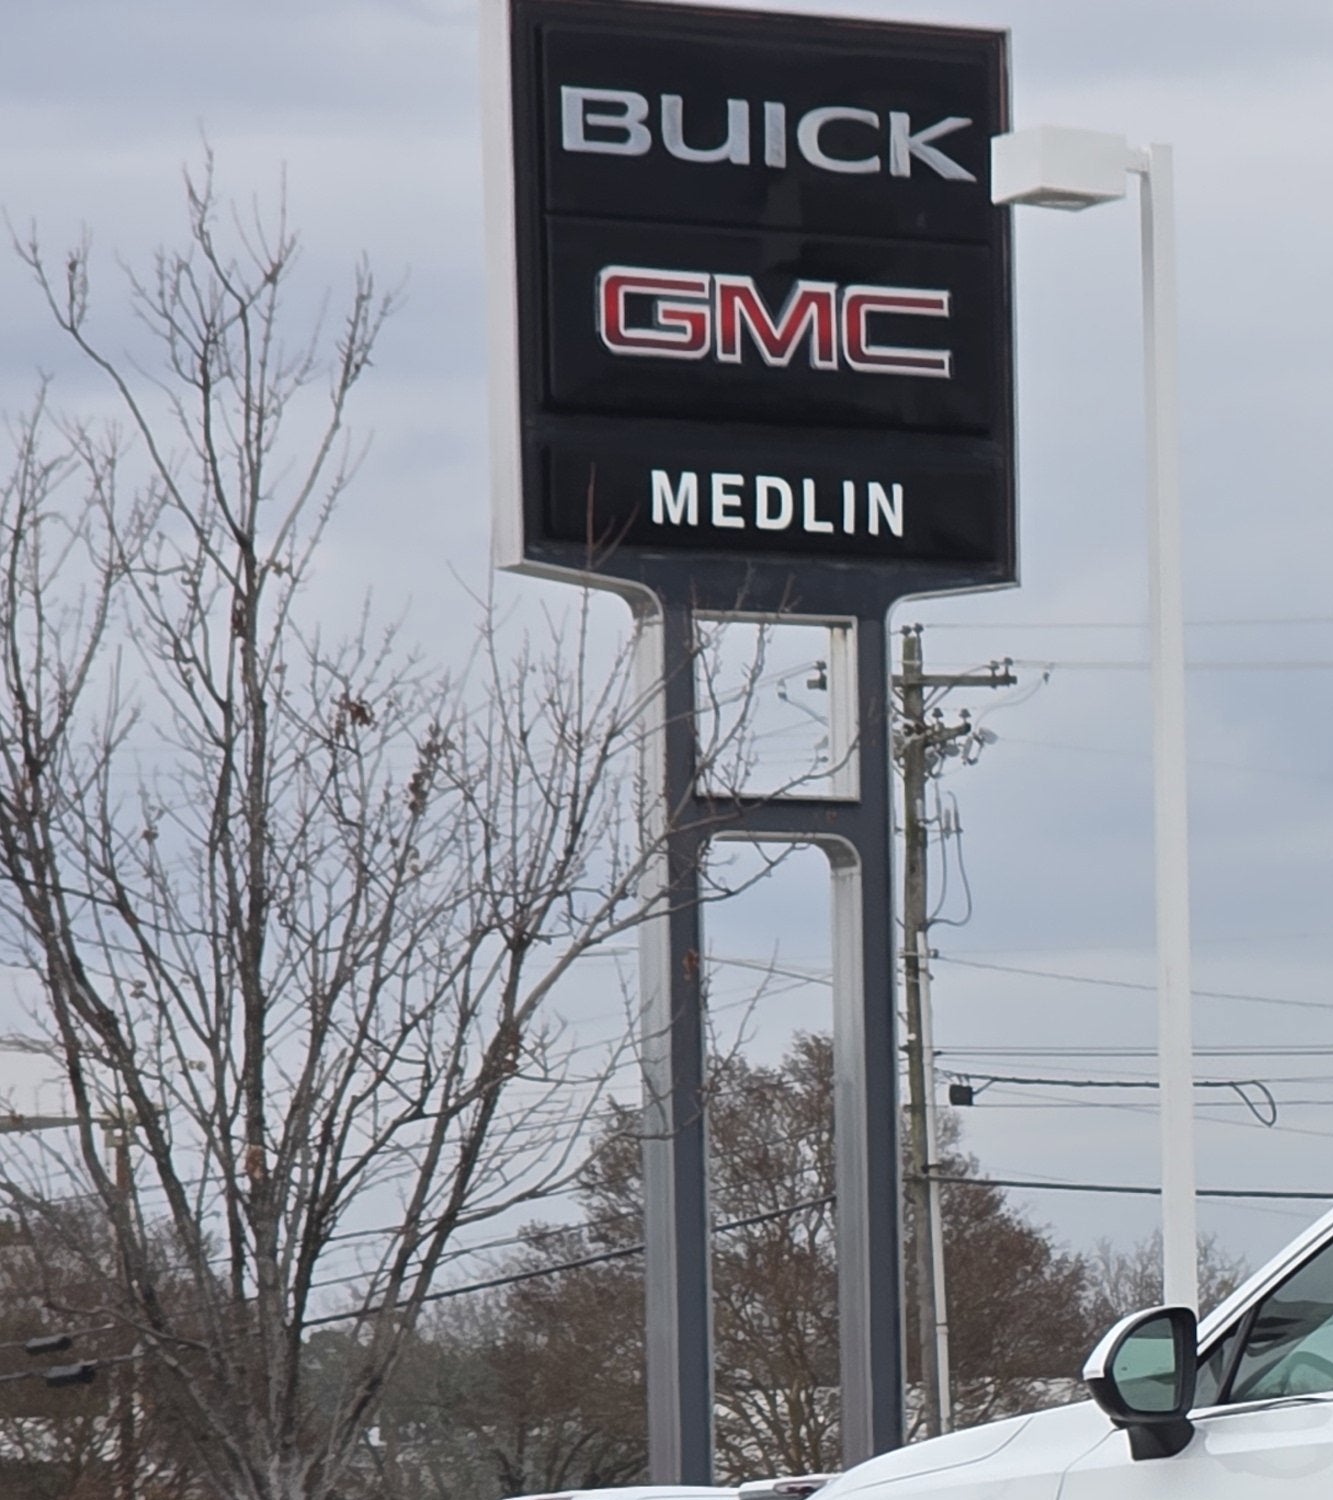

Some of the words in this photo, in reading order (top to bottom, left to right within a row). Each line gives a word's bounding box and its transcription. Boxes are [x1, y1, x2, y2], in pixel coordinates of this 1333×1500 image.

[560, 85, 977, 183] BUICK
[598, 264, 952, 379] GMC
[651, 469, 905, 537] MEDLIN
